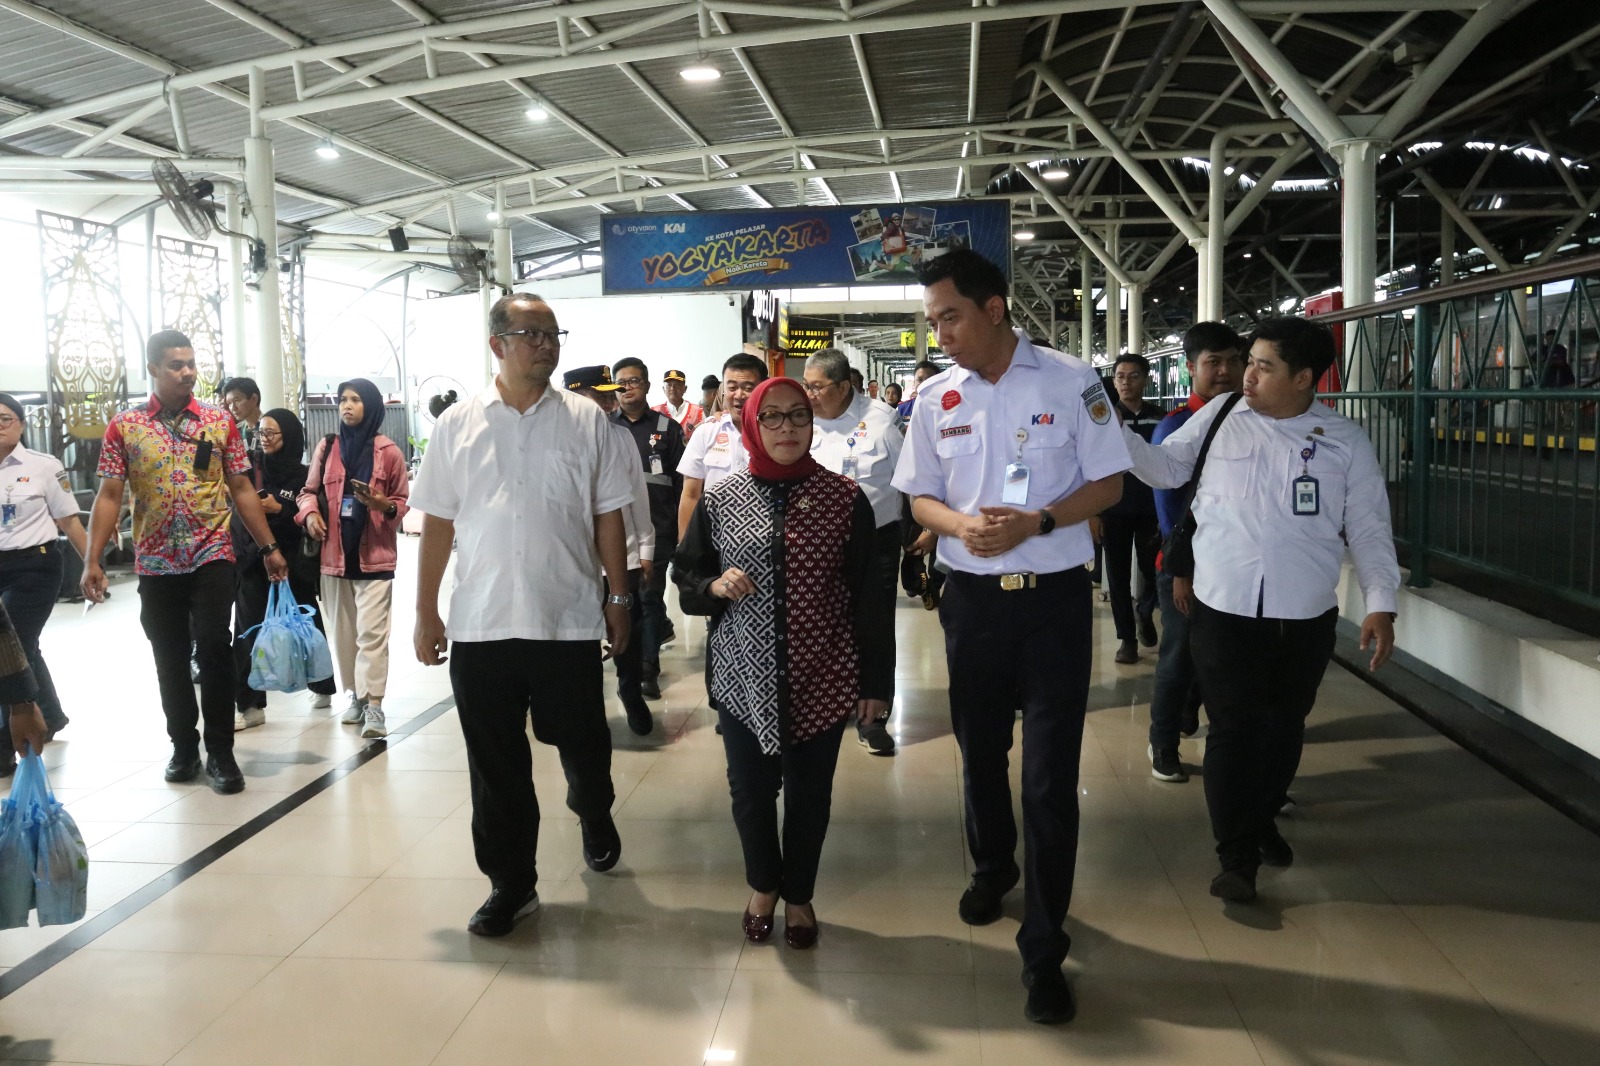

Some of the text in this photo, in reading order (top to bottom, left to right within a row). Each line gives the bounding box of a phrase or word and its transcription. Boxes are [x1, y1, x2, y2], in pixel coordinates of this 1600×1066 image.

[627, 225, 657, 234] cityvision
[663, 223, 686, 234] KAI
[715, 232, 734, 240] KOTA
[735, 224, 766, 236] PELAJAR
[643, 220, 831, 284] YOGYAKARTA
[725, 261, 768, 275] Naik Kereta
[788, 339, 832, 350] SALMAN
[1031, 413, 1055, 426] KAI
[942, 427, 971, 437] BAMBANG
